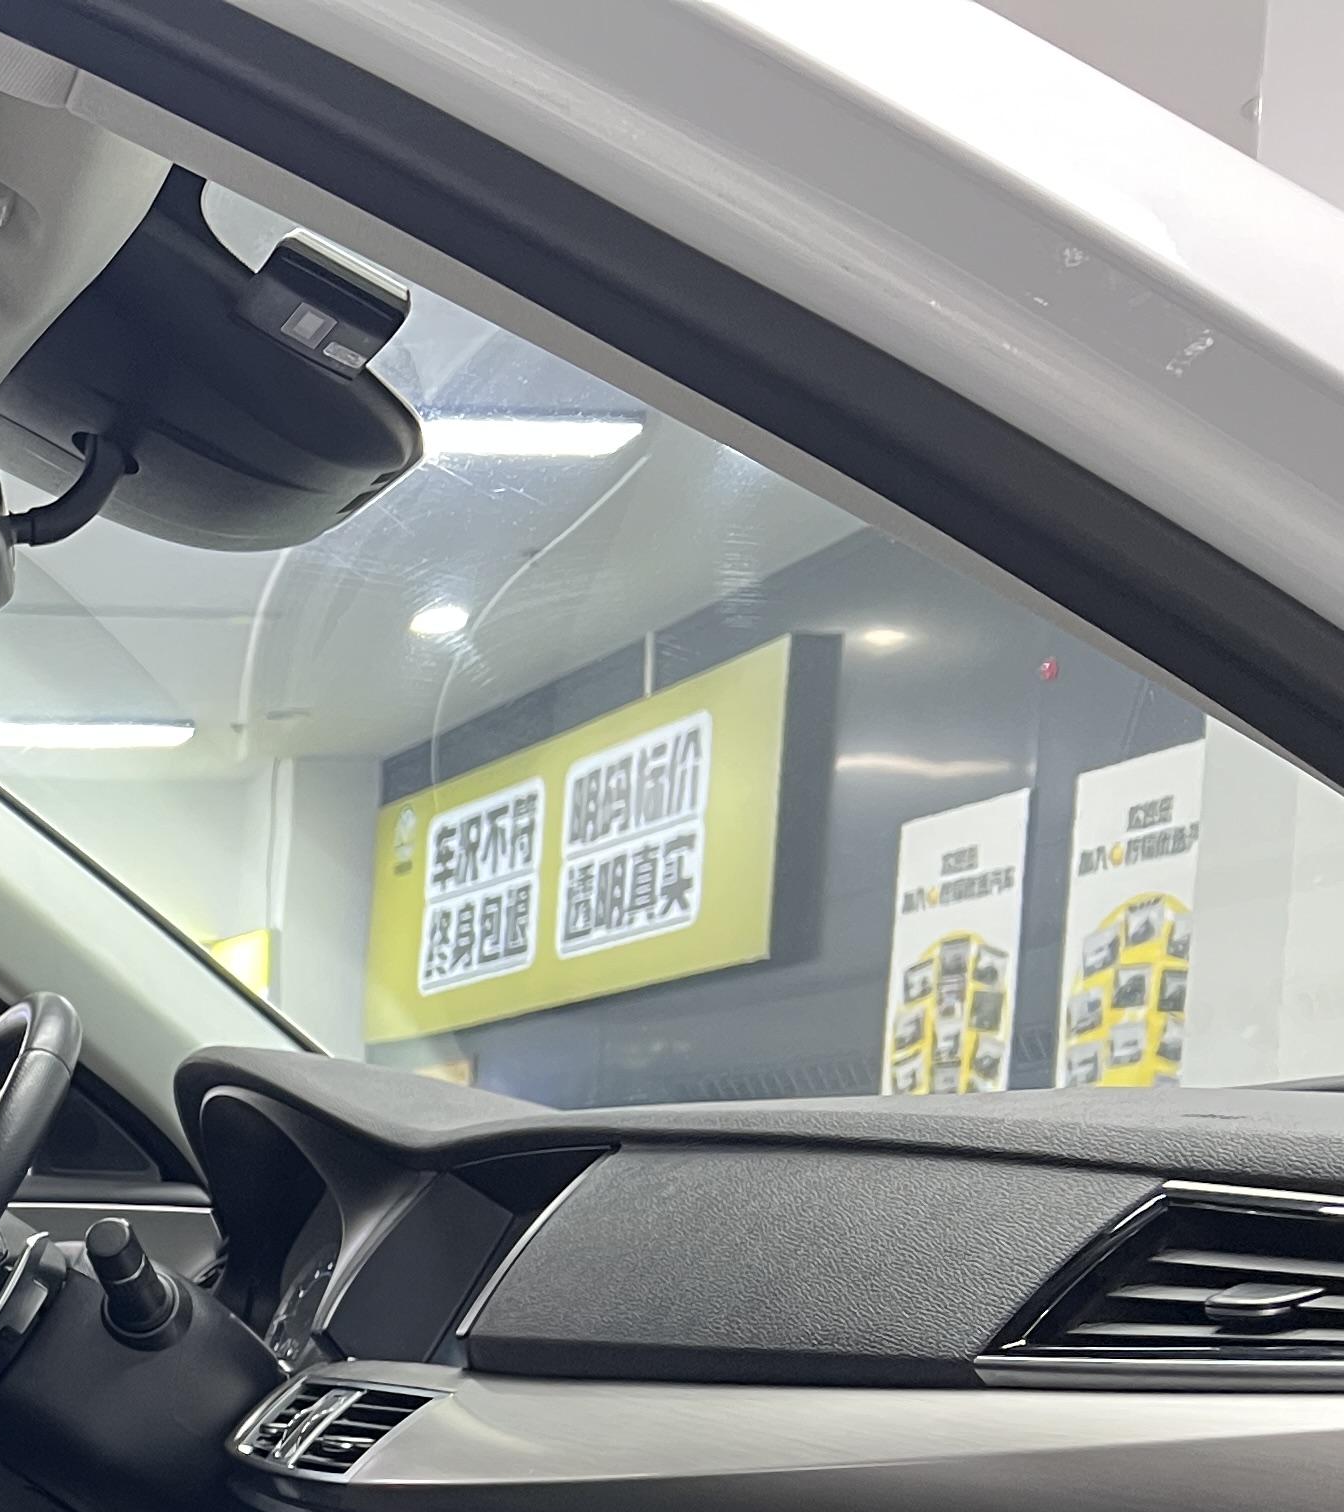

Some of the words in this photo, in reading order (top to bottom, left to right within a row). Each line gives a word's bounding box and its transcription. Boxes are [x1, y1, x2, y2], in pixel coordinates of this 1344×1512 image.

[423, 885, 531, 980] 终身包退
[562, 825, 698, 940] 透明真实
